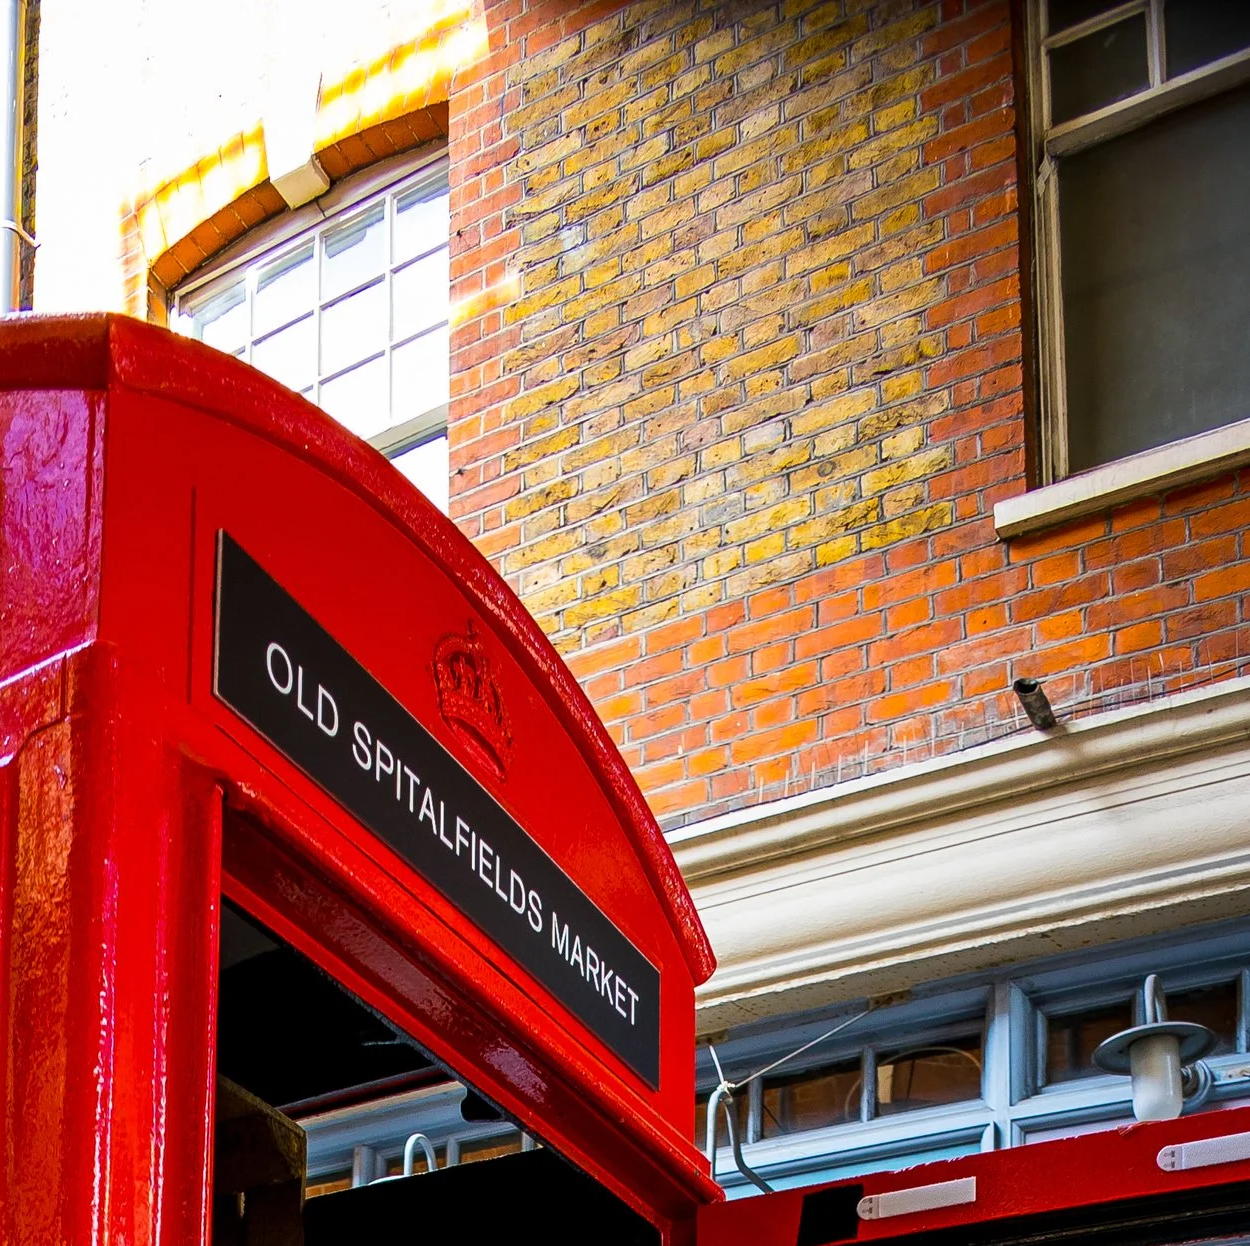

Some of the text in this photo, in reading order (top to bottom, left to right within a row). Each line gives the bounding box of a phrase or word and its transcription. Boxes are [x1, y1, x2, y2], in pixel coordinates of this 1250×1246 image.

[266, 642, 639, 1026] OLD SPITALFIELDS MARKET
